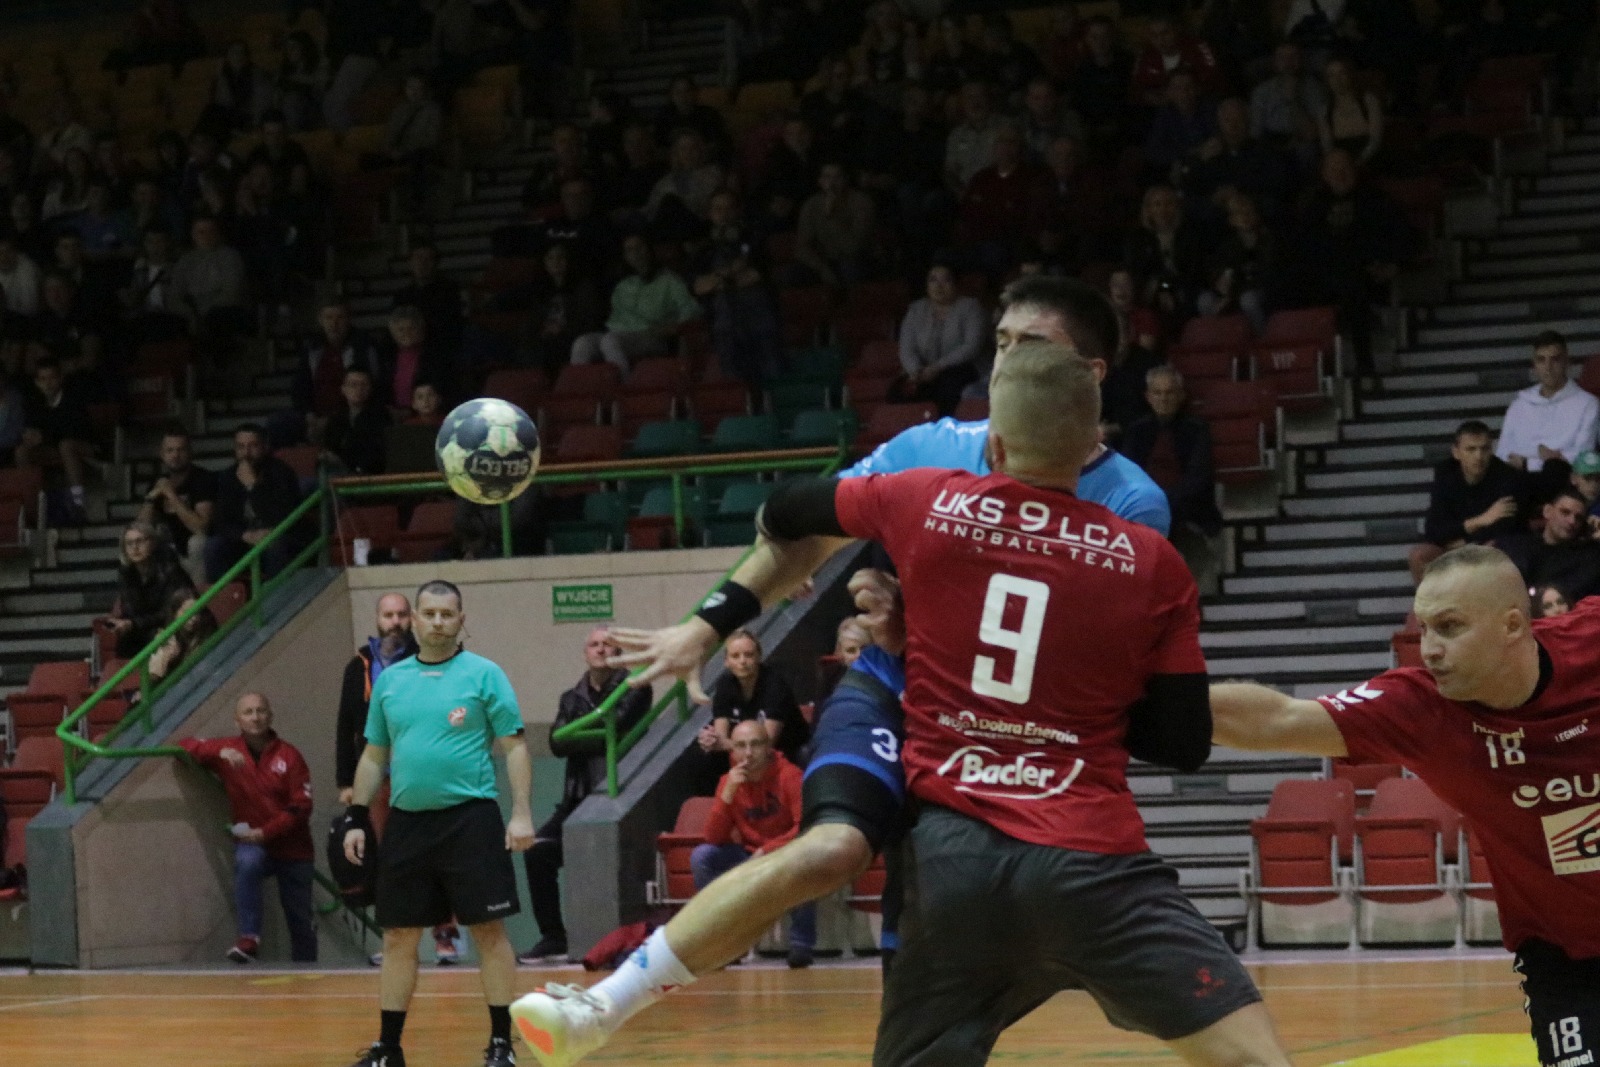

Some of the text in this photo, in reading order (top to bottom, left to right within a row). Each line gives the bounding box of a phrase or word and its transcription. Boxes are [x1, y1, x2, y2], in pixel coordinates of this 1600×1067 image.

[932, 489, 1135, 556] UKS 9 LCA
[924, 517, 1135, 575] HANDBALL TEAM
[971, 572, 1050, 705] 9
[871, 727, 898, 762] 3
[979, 718, 1023, 735] Dobra
[1024, 721, 1079, 745] Energia
[1473, 721, 1525, 739] huel
[1485, 732, 1526, 769] 18
[1548, 1016, 1583, 1058] 18
[1546, 1049, 1594, 1067] mmel
